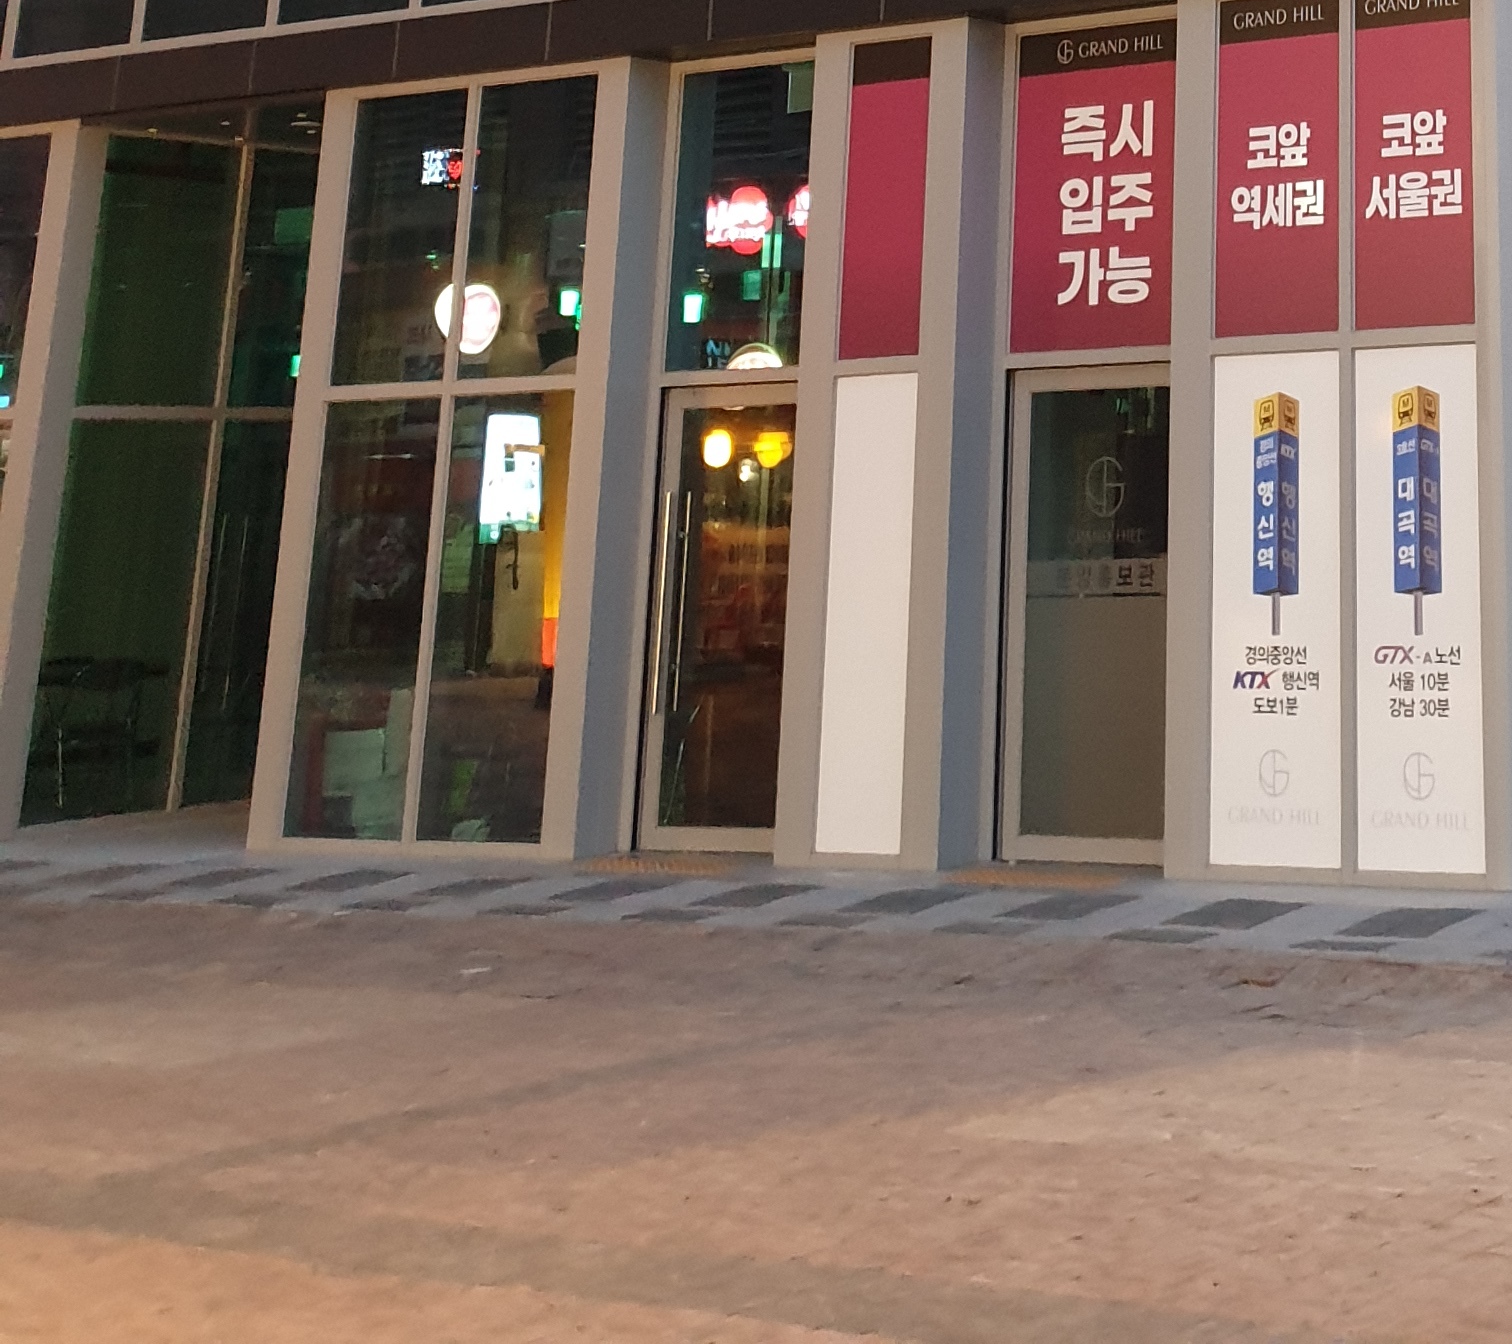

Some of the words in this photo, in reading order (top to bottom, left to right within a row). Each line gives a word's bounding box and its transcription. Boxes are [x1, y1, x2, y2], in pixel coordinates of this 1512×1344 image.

[1233, 8, 1287, 30] GRAND
[1293, 4, 1325, 23] HILL
[1078, 37, 1129, 59] GRAND
[1134, 33, 1164, 53] HILL
[1061, 100, 1154, 162] 즉시
[1247, 121, 1311, 169] 코앞
[1381, 109, 1447, 158] 코앞
[1059, 172, 1154, 235] 입주
[1231, 179, 1325, 230] 역세권
[1365, 168, 1463, 219] 서울권
[1057, 246, 1152, 306] 가능
[1245, 645, 1307, 666] 경의중앙선
[1233, 668, 1280, 690] KTX
[1282, 670, 1320, 691] 행신역
[1388, 671, 1415, 692] 서울
[1420, 671, 1450, 692] 10분
[1252, 696, 1299, 716] 도보1분
[1389, 697, 1416, 718] 강남
[1419, 697, 1450, 718] 30분
